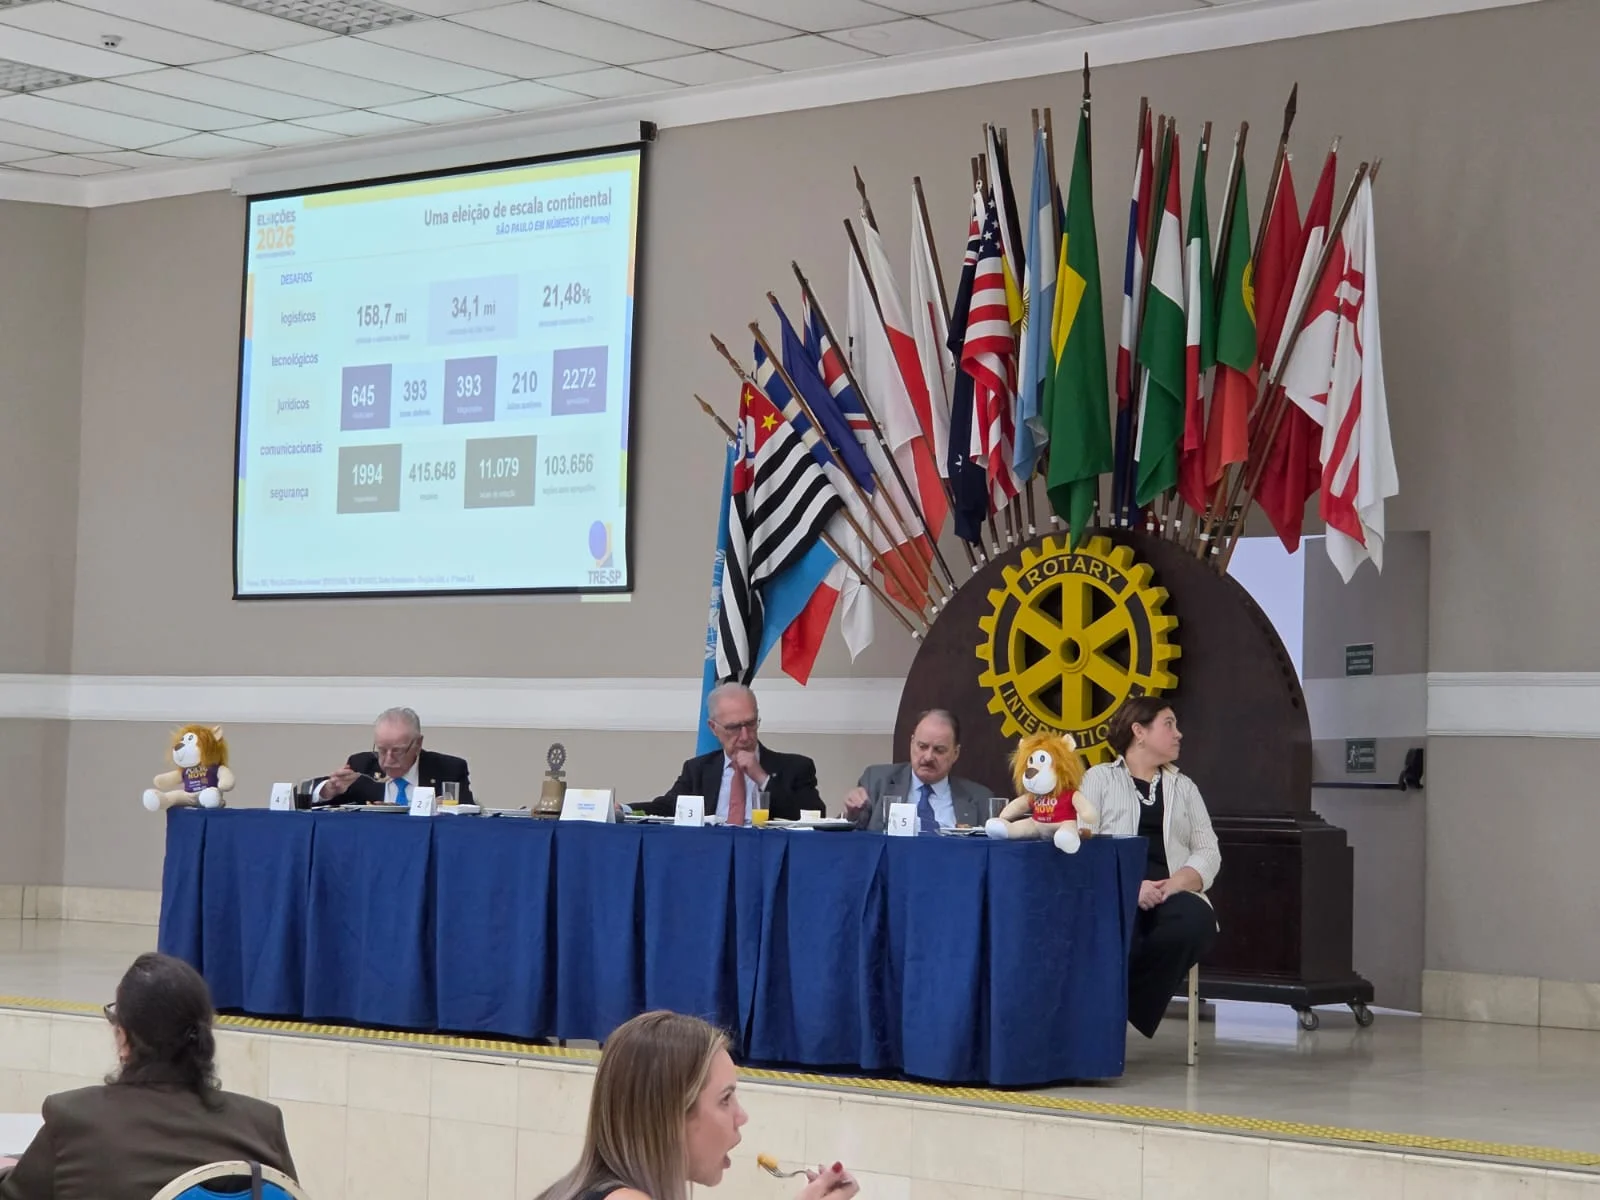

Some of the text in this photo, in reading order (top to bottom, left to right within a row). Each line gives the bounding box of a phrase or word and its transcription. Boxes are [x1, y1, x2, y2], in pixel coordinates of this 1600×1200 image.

[424, 186, 612, 226] Uma eleição de escala continental
[496, 222, 510, 235] SÃO
[511, 222, 534, 234] PAULO
[534, 220, 545, 231] EM
[545, 216, 580, 230] NÚMEROS
[256, 225, 296, 250] 2026
[280, 271, 313, 286] DESAFIOS
[542, 281, 592, 311] 21,48%
[357, 303, 407, 329] 158,7 mi
[451, 295, 496, 321] 34,1 mi
[271, 352, 319, 368] tecnológicos
[456, 375, 482, 398] 393
[511, 370, 538, 394] 210
[562, 367, 596, 390] 2272
[351, 384, 375, 407] 645
[403, 379, 427, 402] 393
[259, 440, 322, 456] comunicacionais
[352, 462, 384, 486] 1994
[408, 460, 456, 482] 415.648
[479, 457, 520, 479] 11.079
[544, 453, 594, 476] 103.656
[269, 488, 309, 502] segurança
[588, 569, 622, 585] TRE-SP
[1025, 555, 1120, 588] ROTARY
[687, 809, 693, 818] 3
[901, 817, 907, 827] 5
